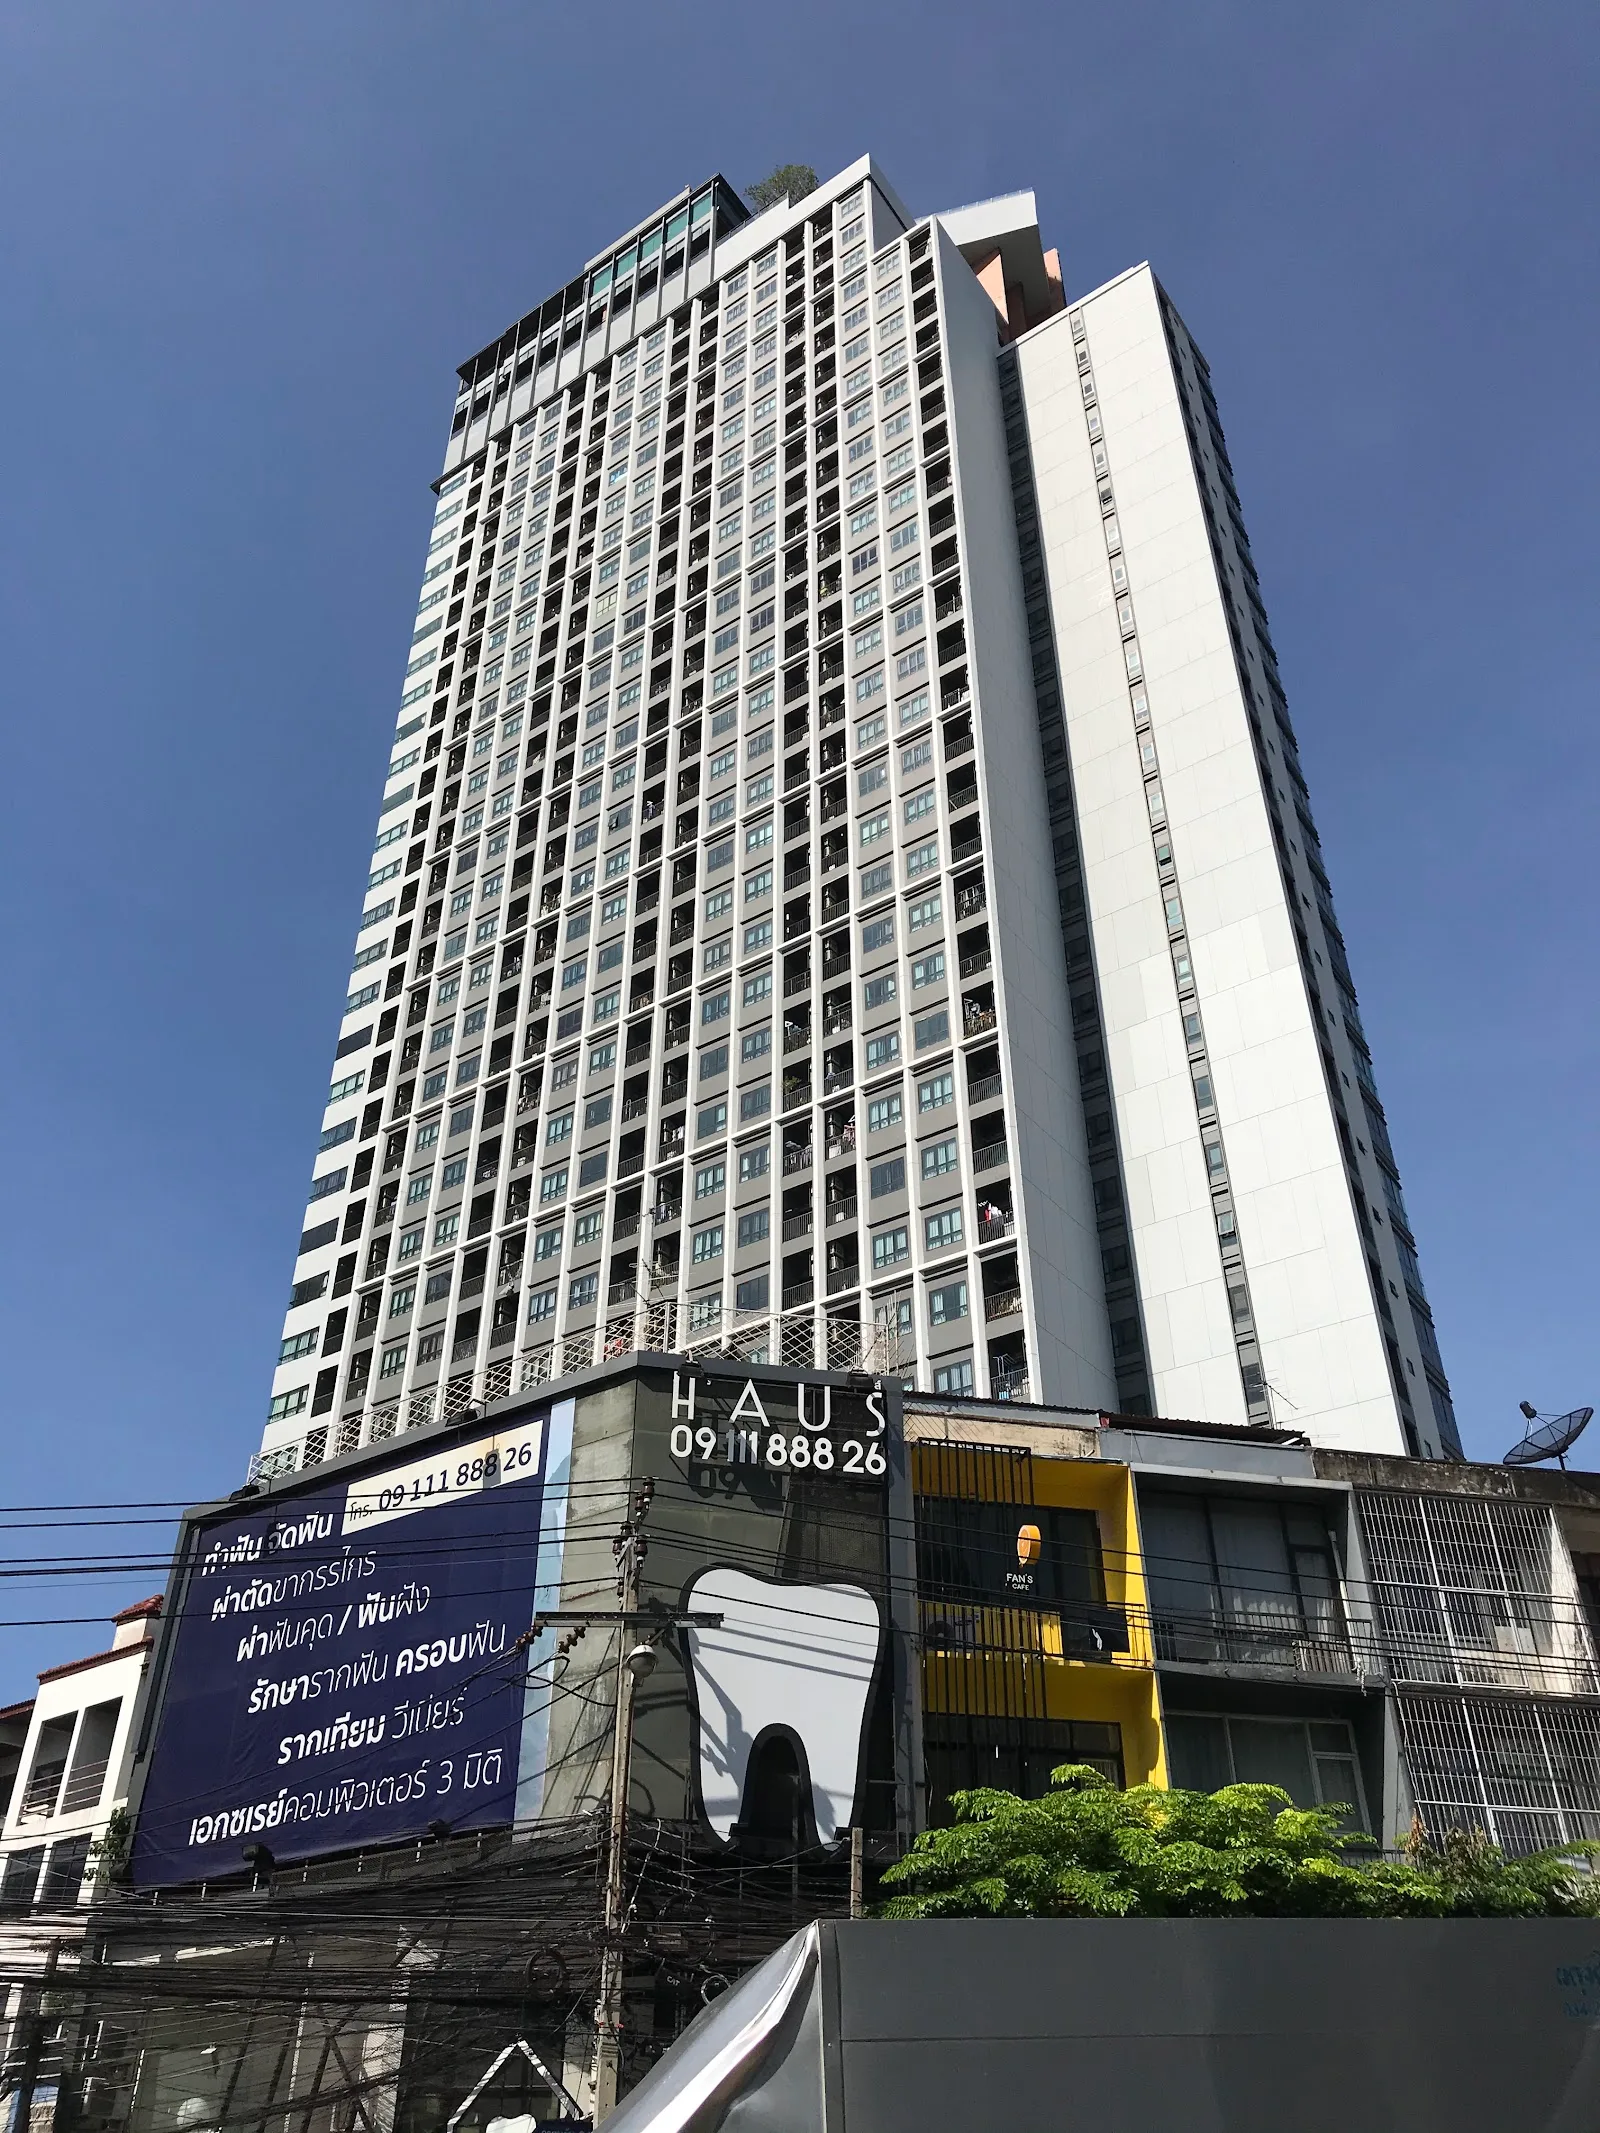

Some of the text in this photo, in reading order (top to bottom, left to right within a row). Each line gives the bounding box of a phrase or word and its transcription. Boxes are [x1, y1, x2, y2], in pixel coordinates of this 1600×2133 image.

[671, 1371, 886, 1437] HAUS
[456, 1453, 498, 1487] 888
[503, 1442, 532, 1472] 26
[670, 1425, 717, 1460] 09
[766, 1433, 835, 1471] 888
[842, 1440, 887, 1475] 26
[1006, 1573, 1033, 1583] FAN'S
[247, 1620, 506, 1713] รักษารากฟัน ครอบฟัน
[436, 1759, 454, 1794] 3
[463, 1748, 503, 1790] มิติ
